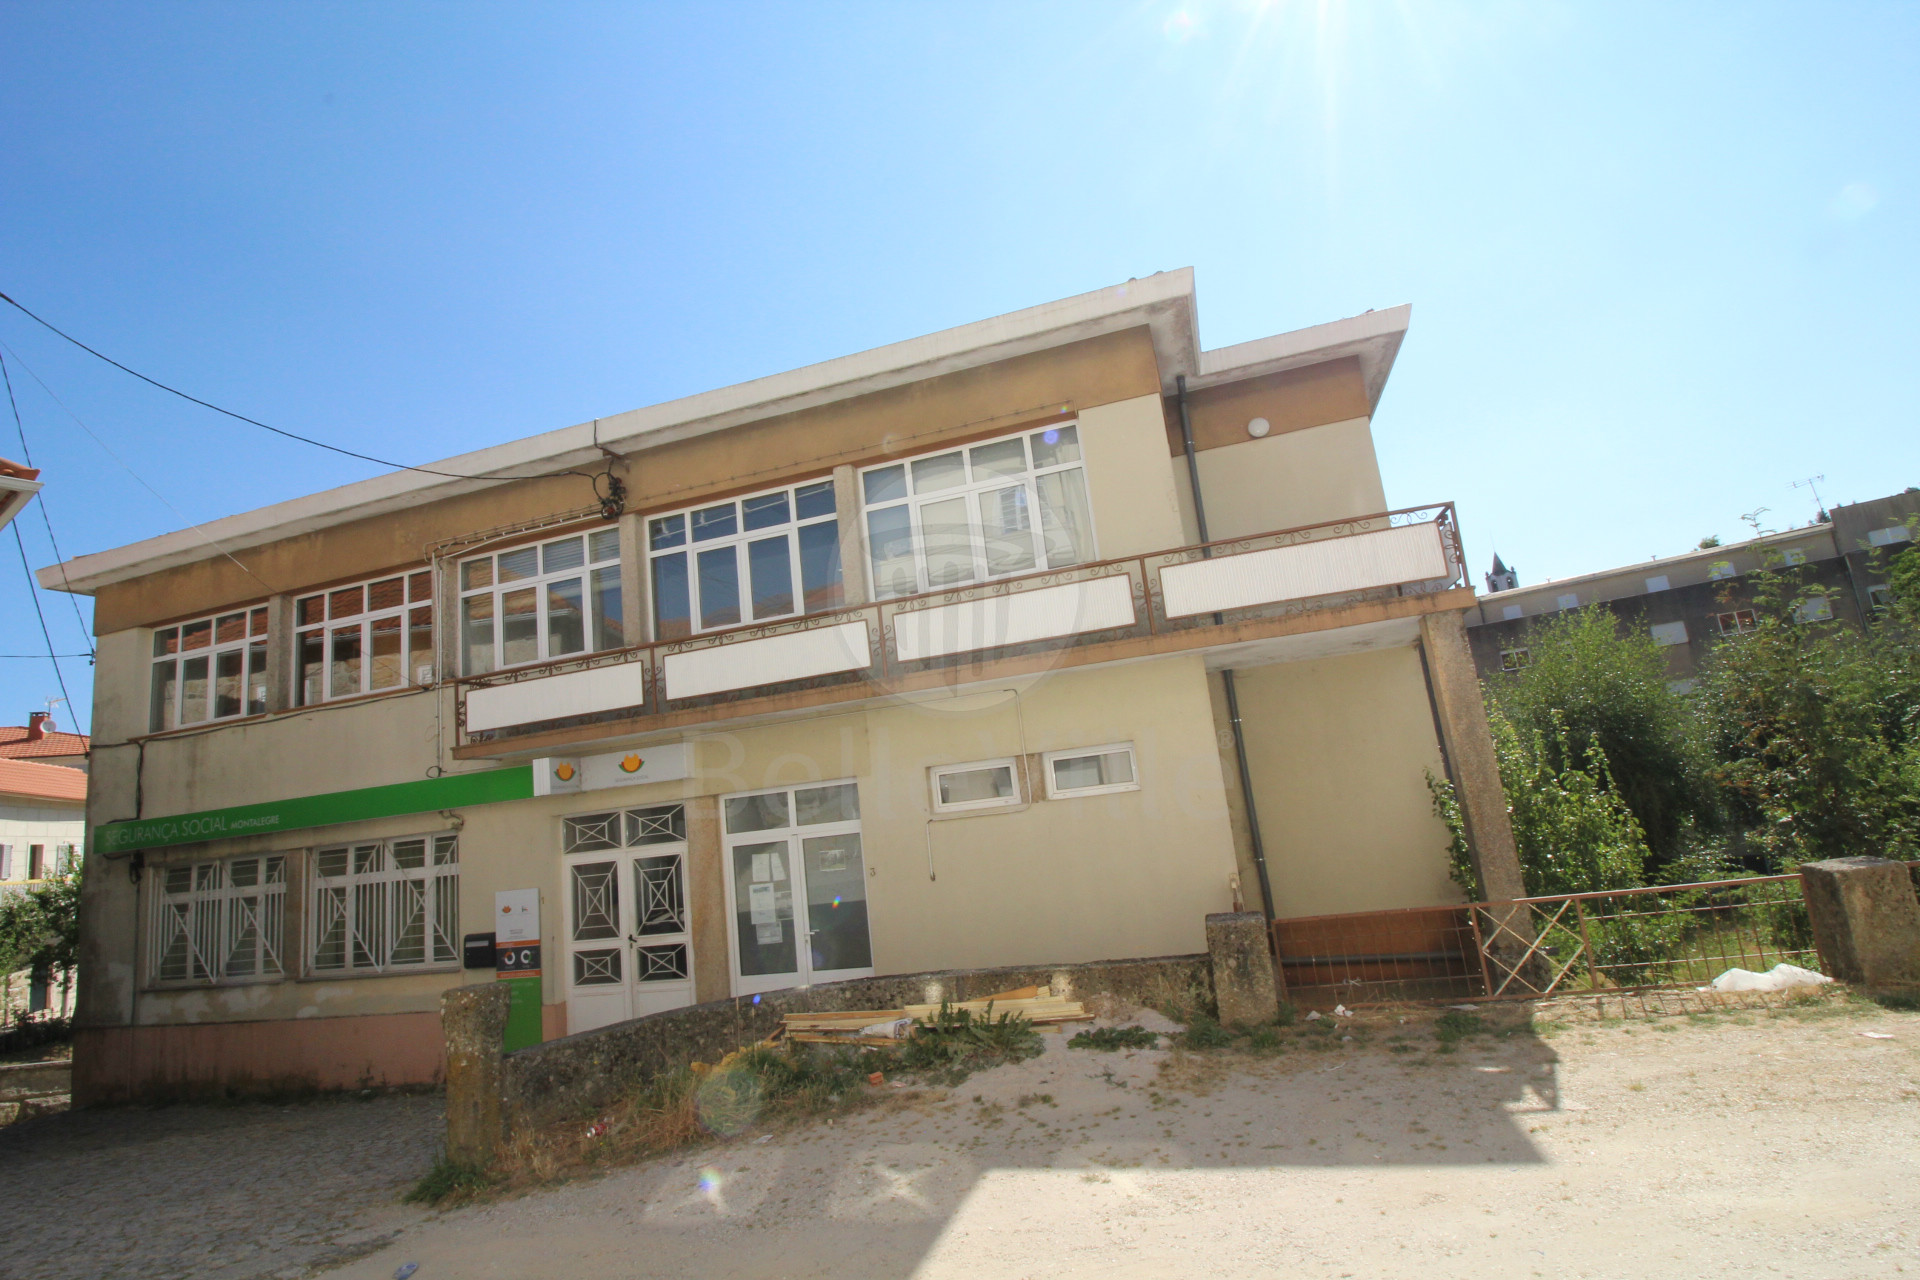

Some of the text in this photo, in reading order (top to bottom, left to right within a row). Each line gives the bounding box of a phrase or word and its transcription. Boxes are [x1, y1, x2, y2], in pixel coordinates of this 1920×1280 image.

[105, 814, 280, 846] SEGURANÇA SOCIAL MONTALEGRE
